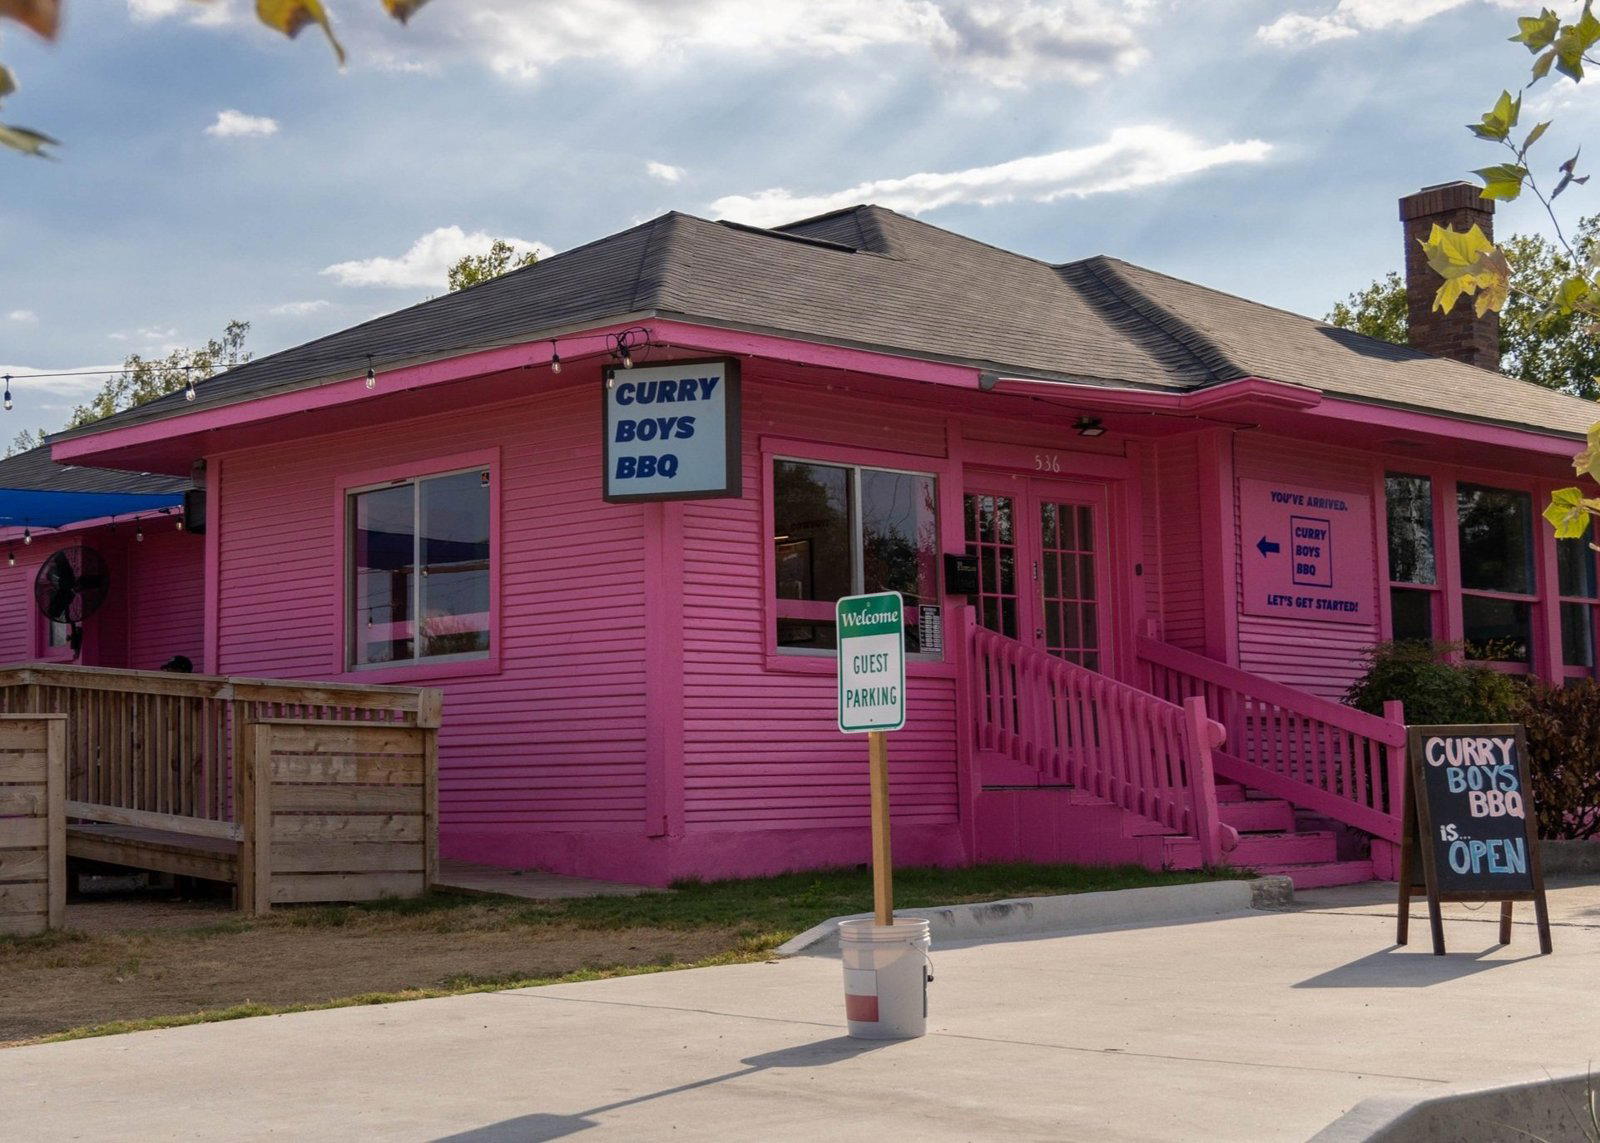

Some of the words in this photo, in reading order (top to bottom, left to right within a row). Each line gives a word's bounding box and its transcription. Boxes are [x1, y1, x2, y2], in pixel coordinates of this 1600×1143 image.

[615, 377, 720, 406] CURRY
[615, 416, 696, 443] BOYS
[615, 453, 679, 479] BBQ
[1034, 455, 1061, 473] 536
[1270, 491, 1304, 506] YOU'VE
[1306, 496, 1348, 511] ARRIVED.
[1295, 527, 1327, 540] CURRY
[1296, 545, 1320, 558] BOYS
[1296, 563, 1316, 576] BBQ
[1267, 594, 1293, 607] LET'S
[1295, 596, 1314, 609] GET
[1316, 598, 1359, 612] STARTED!
[841, 609, 899, 627] Welcome
[853, 653, 889, 674] GUEST
[846, 686, 897, 708] PARKING
[1425, 736, 1515, 767] CURRY
[1446, 764, 1519, 793] BOYS
[1468, 790, 1525, 819] BBQ
[1448, 837, 1526, 874] OPEN
